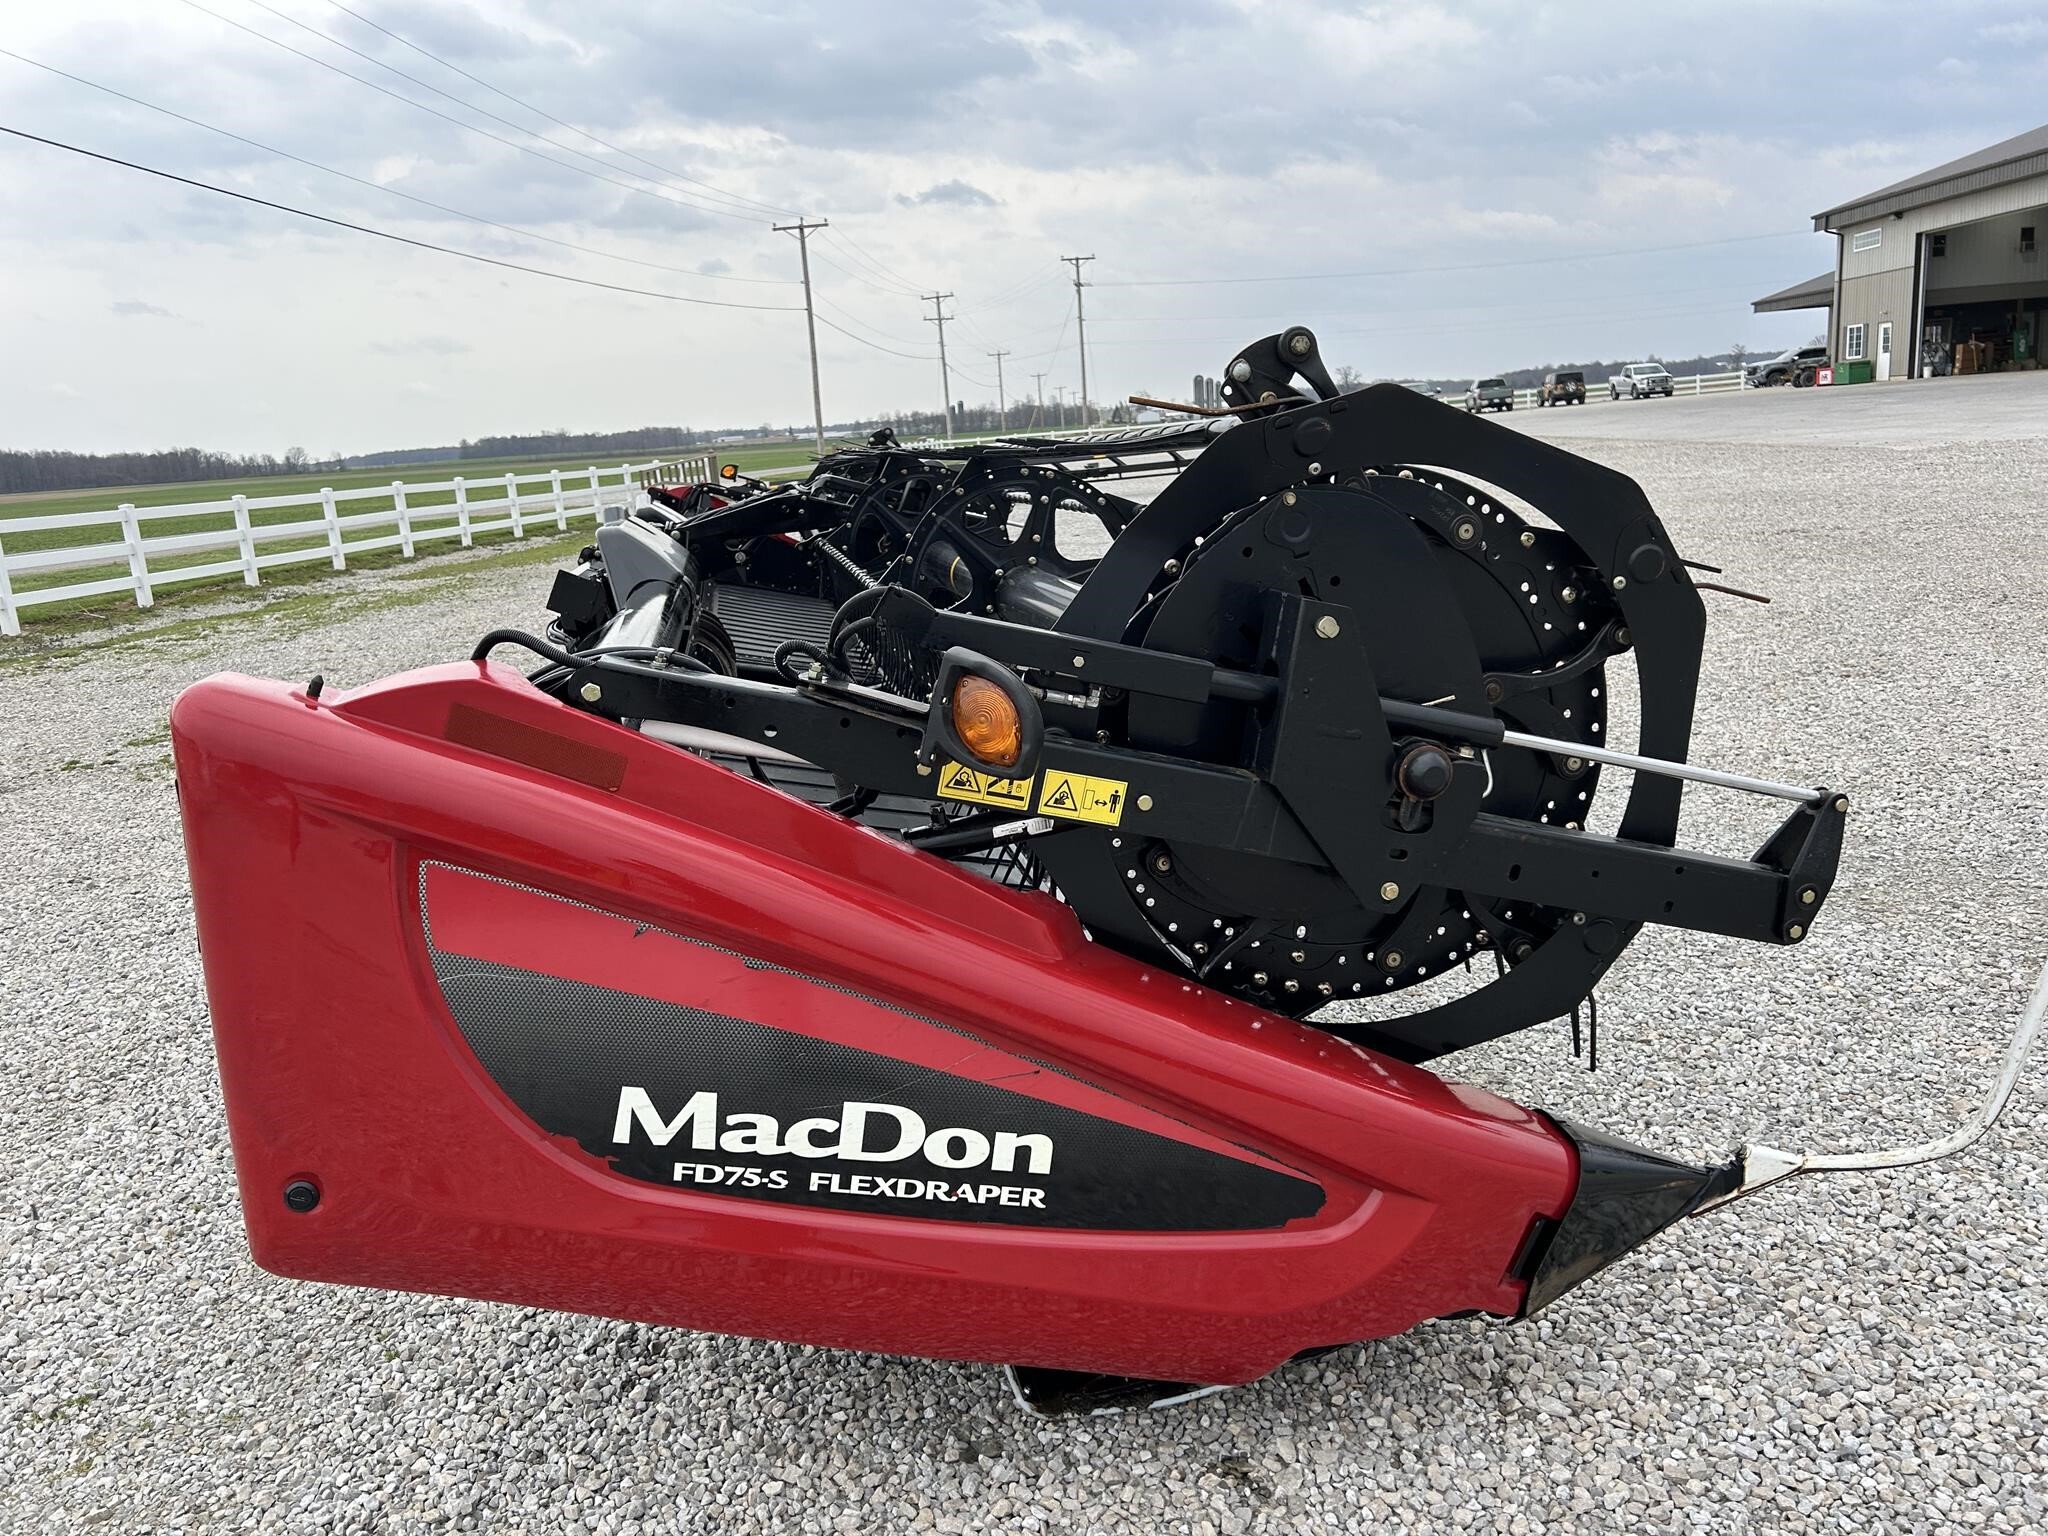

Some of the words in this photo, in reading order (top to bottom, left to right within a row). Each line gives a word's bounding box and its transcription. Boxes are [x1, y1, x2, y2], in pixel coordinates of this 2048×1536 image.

[612, 1085, 1054, 1175] MacDon
[672, 1162, 789, 1189] FD75-S
[808, 1171, 1047, 1209] FLEXDRAPER
